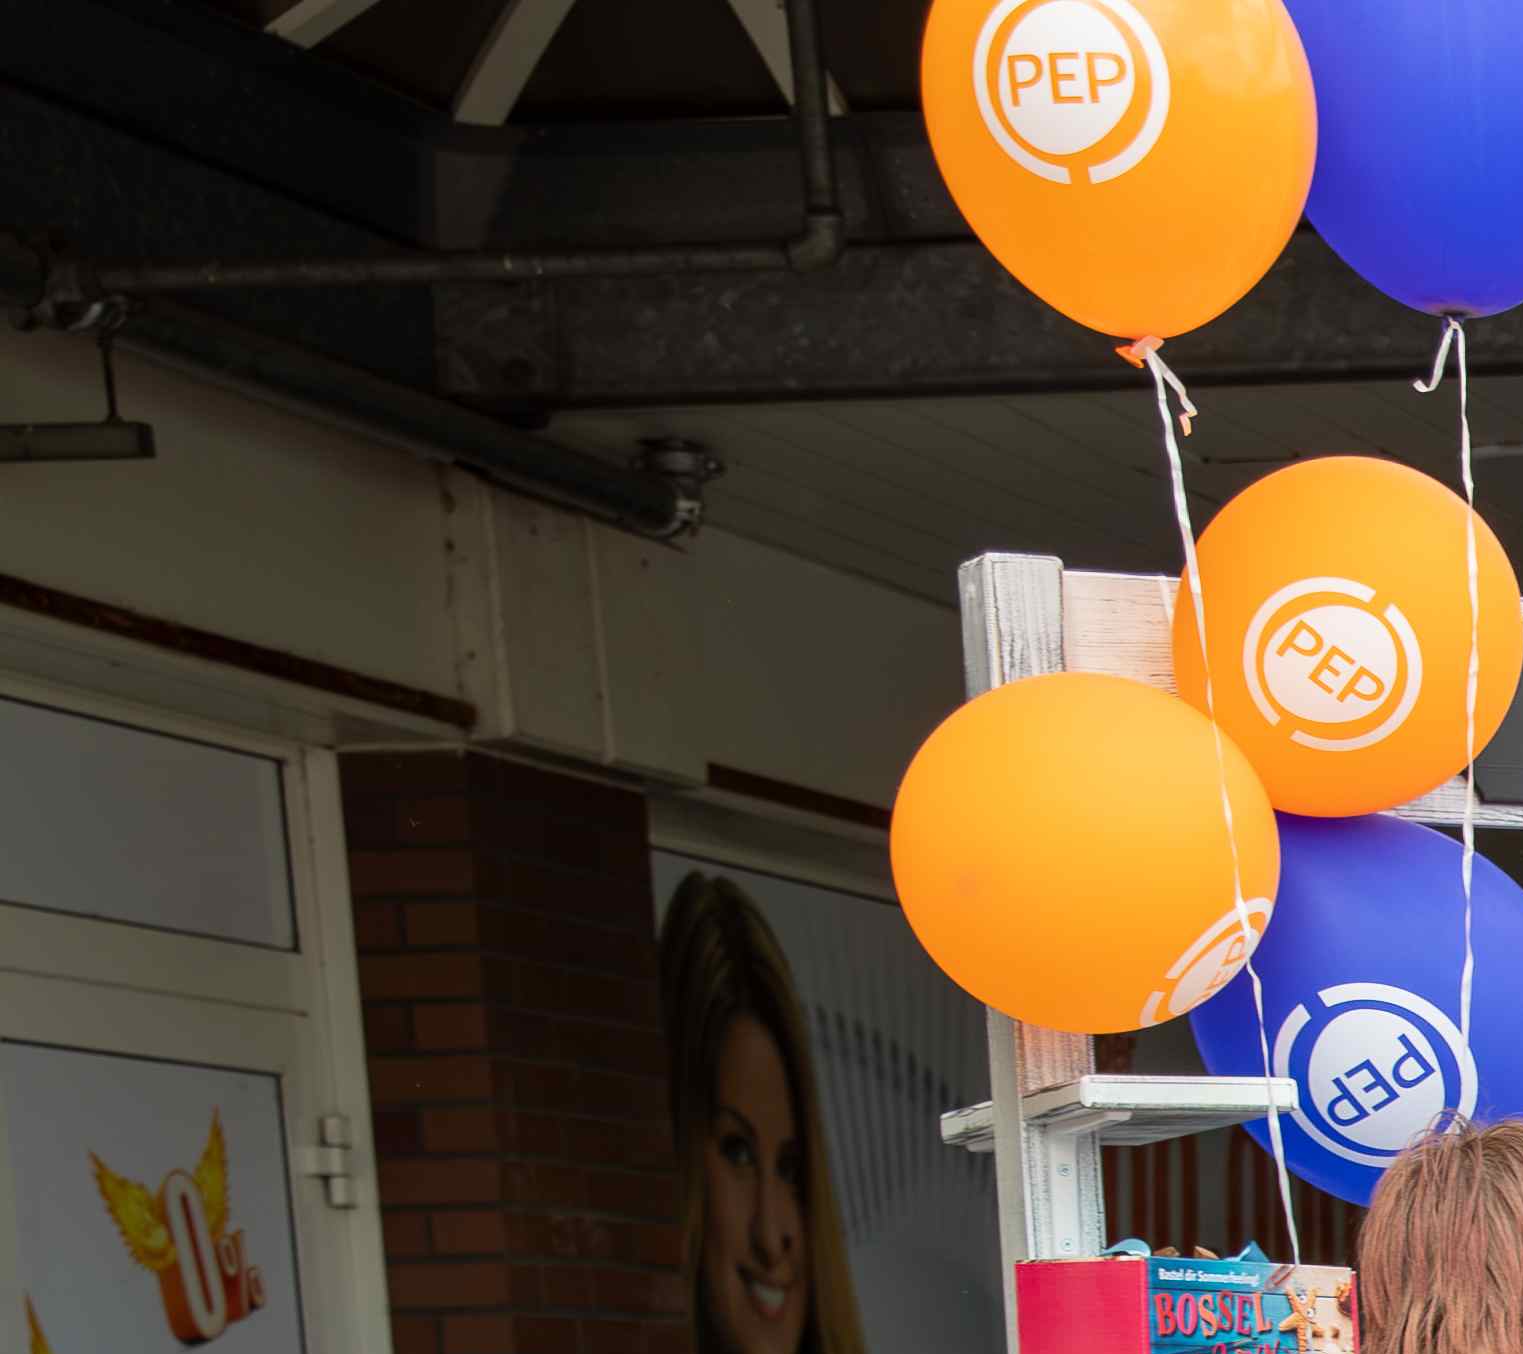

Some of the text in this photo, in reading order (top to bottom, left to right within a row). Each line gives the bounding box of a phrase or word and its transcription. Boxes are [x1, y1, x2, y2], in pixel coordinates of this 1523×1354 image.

[1006, 52, 1127, 108] PEP
[1275, 619, 1385, 705] PEP
[1325, 1032, 1438, 1128] PEP
[1154, 1289, 1273, 1338] BOSSEL
